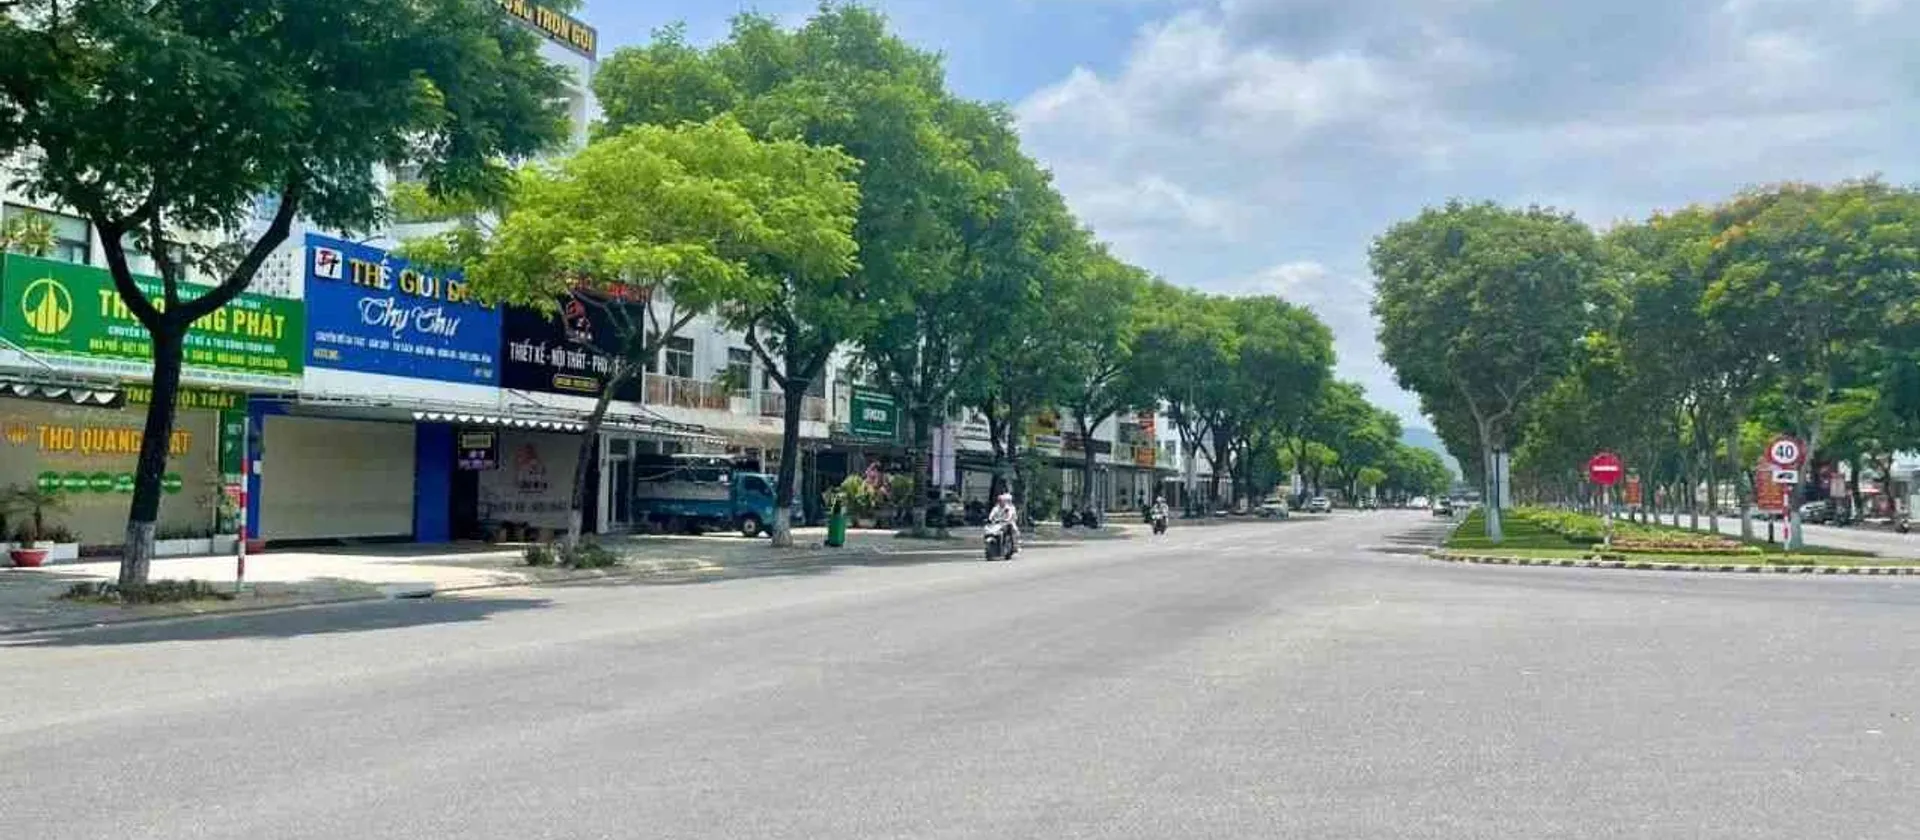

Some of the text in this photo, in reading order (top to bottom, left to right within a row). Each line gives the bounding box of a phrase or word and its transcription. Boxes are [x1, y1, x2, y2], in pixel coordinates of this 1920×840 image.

[98, 289, 140, 327] TH
[233, 307, 285, 339] PHÁT
[510, 338, 533, 363] THIẾT
[534, 341, 546, 364] KẾ
[567, 348, 587, 370] THẤT
[80, 426, 143, 457] QUANG
[1776, 445, 1794, 459] 40
